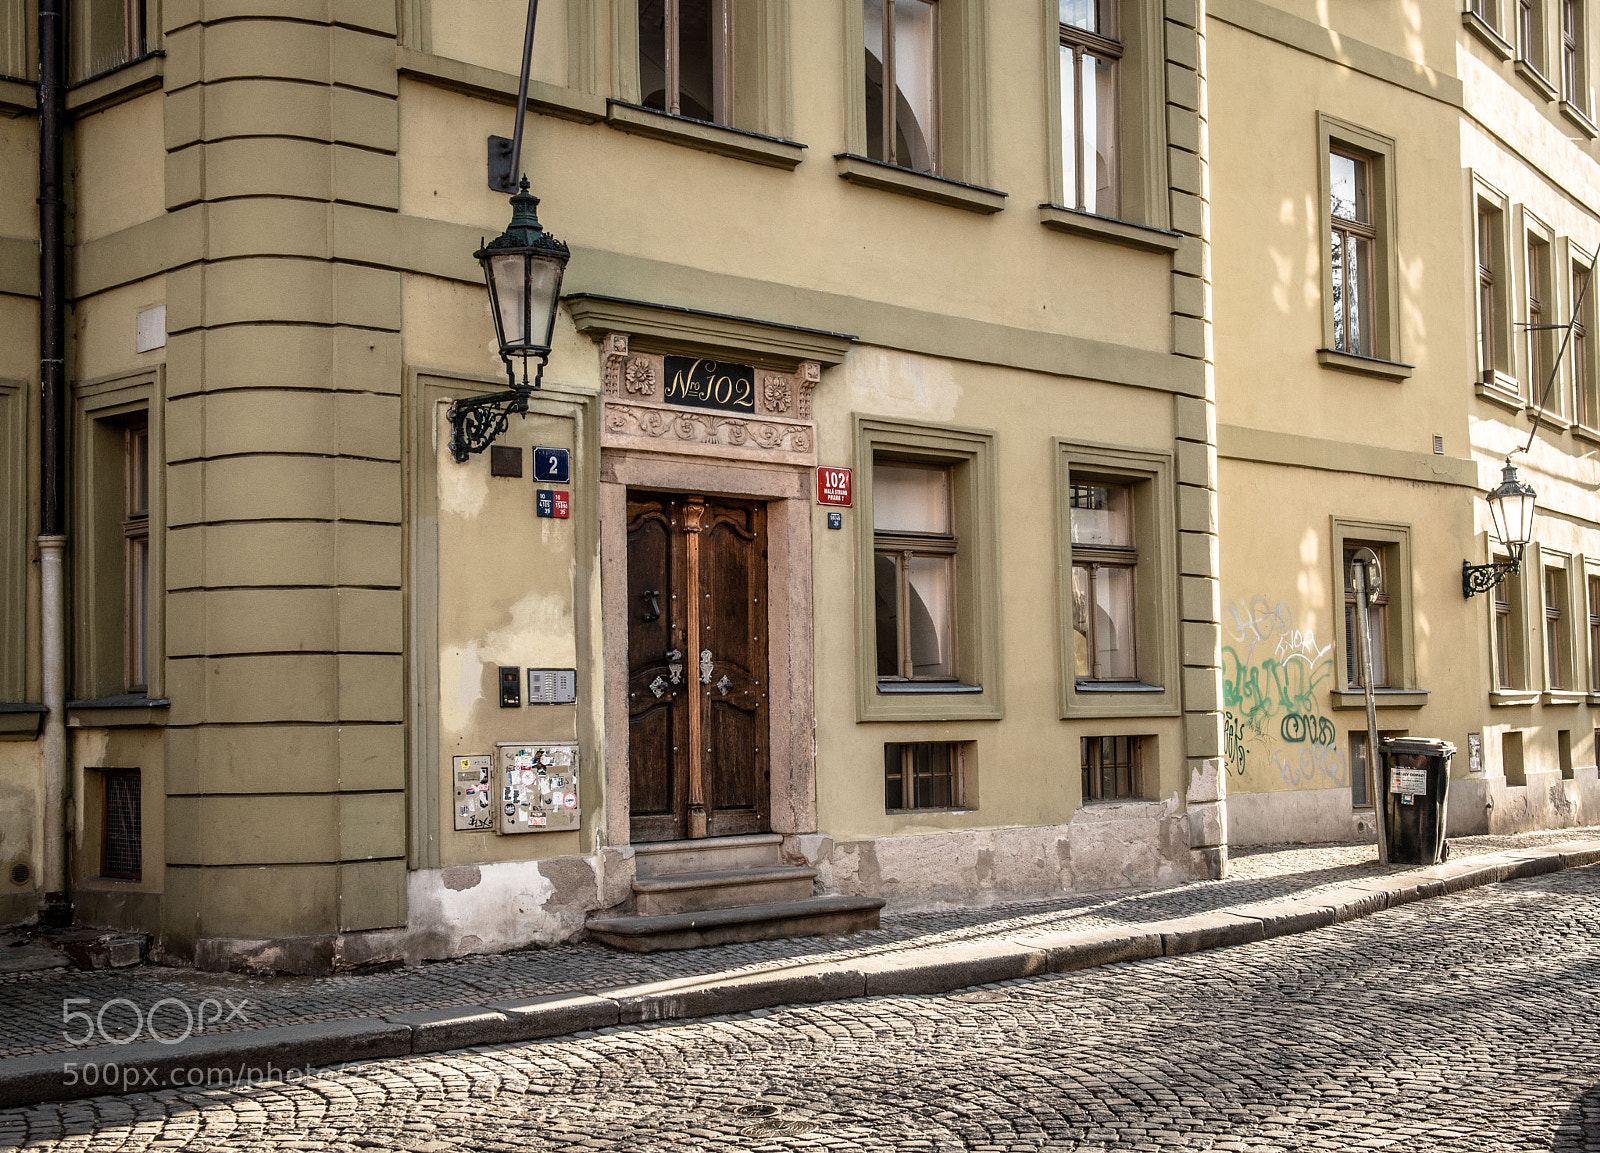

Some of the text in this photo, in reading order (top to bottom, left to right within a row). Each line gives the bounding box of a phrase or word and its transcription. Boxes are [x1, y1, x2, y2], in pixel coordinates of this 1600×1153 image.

[698, 374, 754, 407] 102
[549, 456, 558, 474] 2
[825, 471, 845, 488] 102
